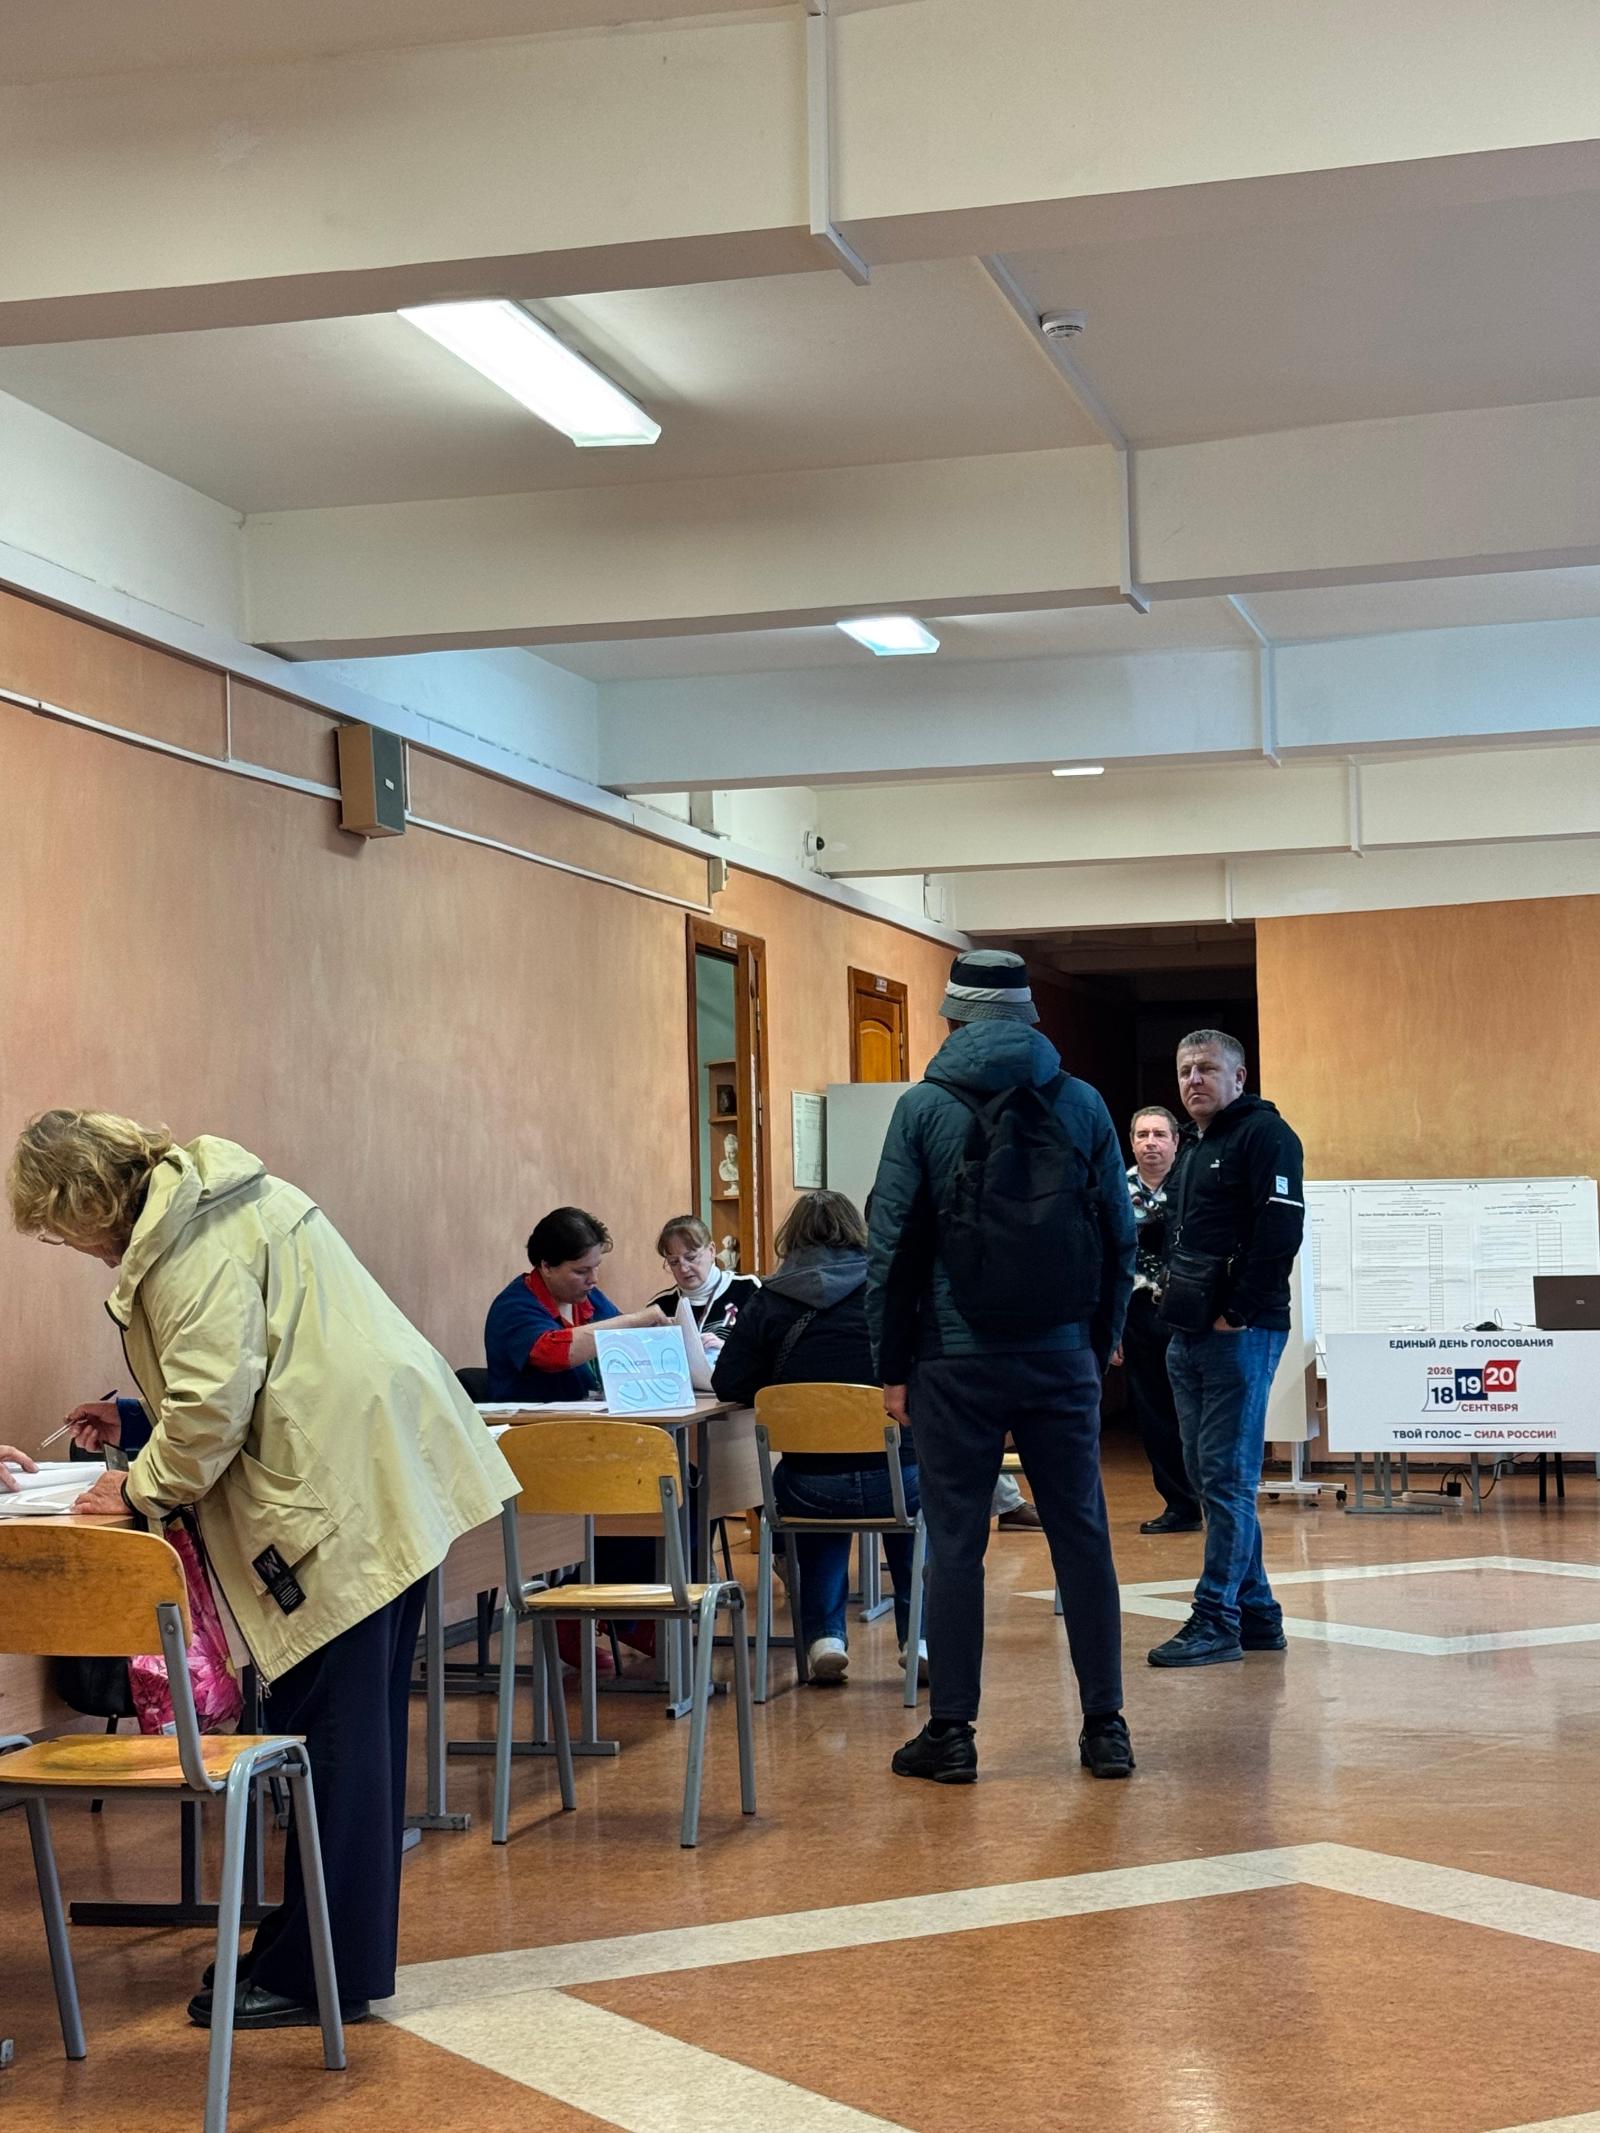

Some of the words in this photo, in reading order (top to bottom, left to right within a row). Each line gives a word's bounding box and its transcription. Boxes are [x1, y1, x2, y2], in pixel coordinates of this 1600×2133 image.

[1389, 1337, 1436, 1349] ЕДИНЫЙ
[1438, 1339, 1468, 1349] ДЕНЬ
[1470, 1338, 1554, 1348] ГОЛОСОВАНИЯ
[1427, 1366, 1453, 1375] 2026
[1431, 1386, 1454, 1404] 18
[1457, 1376, 1482, 1394] 19
[1485, 1367, 1515, 1385] 20
[1461, 1403, 1519, 1412] СЕНТЯБРЯ
[1392, 1428, 1422, 1439] ТВОЙ
[1425, 1430, 1462, 1439] ГОЛОС
[1474, 1430, 1505, 1439] СИЛА
[1507, 1430, 1557, 1439] РОССИИ!
